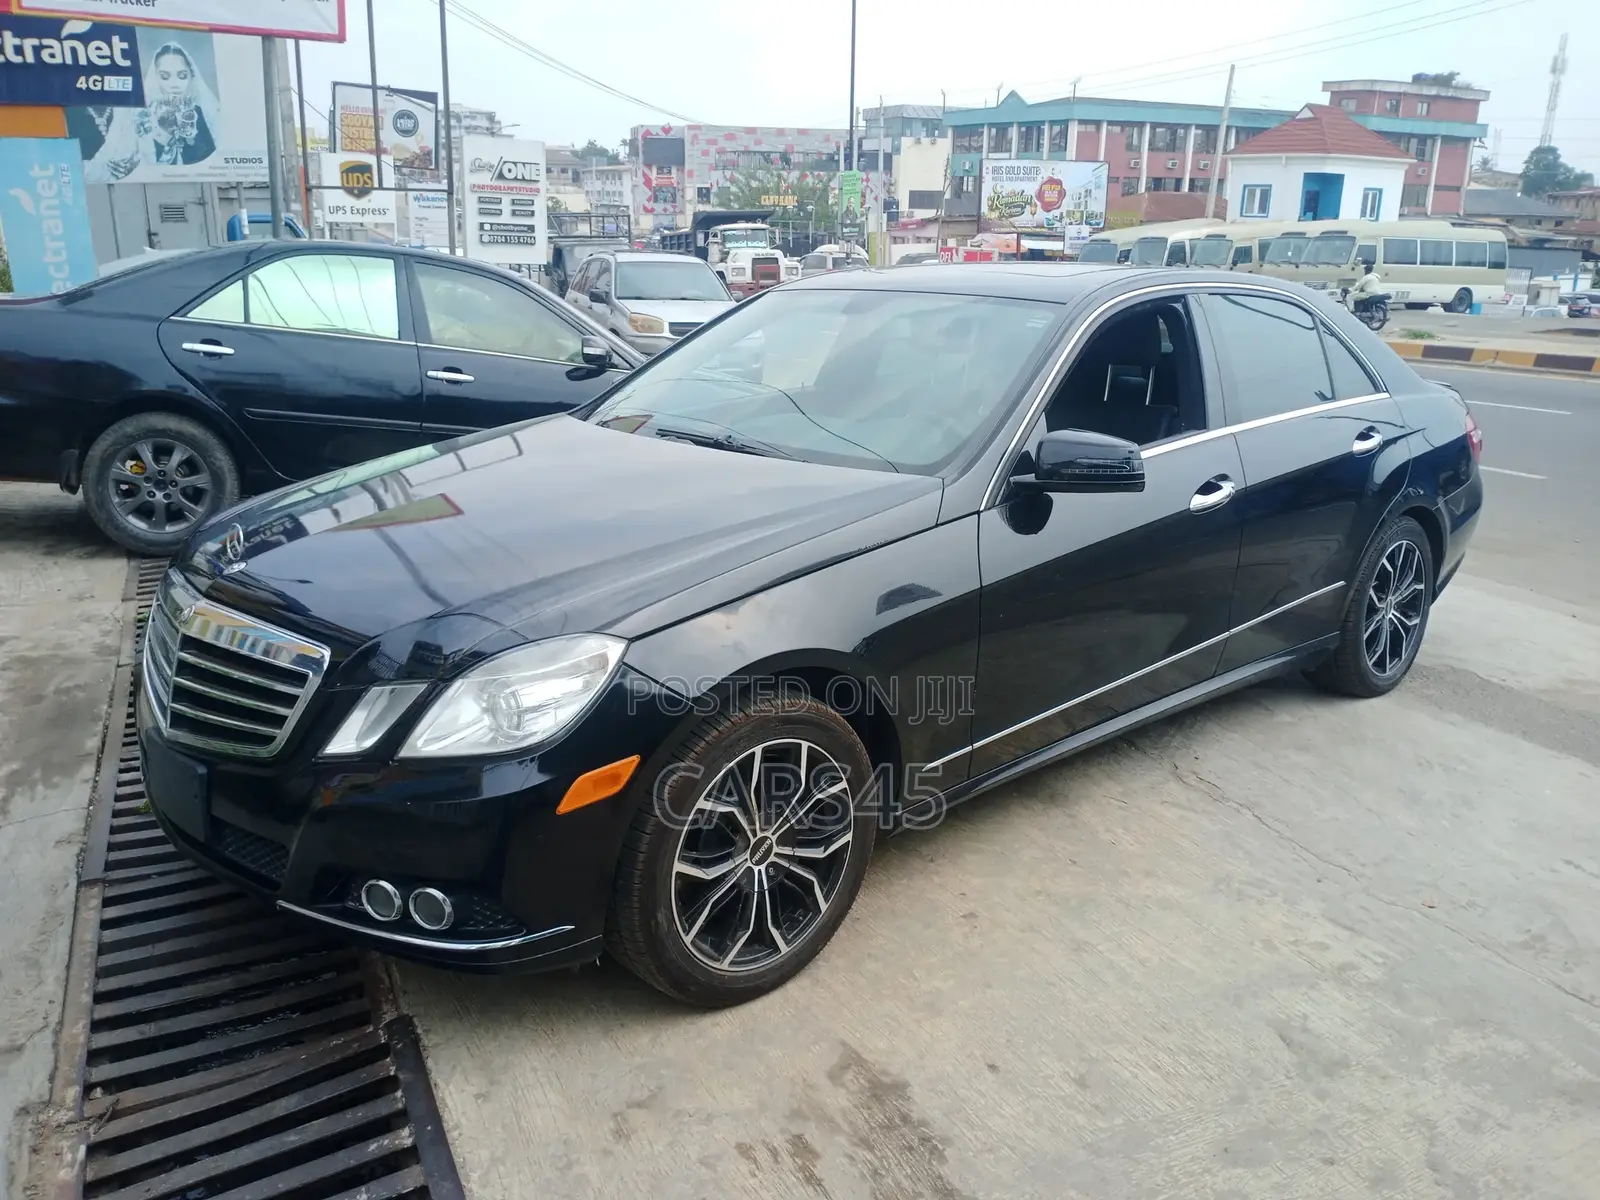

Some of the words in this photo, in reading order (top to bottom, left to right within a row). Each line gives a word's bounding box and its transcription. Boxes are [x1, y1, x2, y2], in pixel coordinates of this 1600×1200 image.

[991, 165, 1004, 175] IRIS
[1005, 165, 1022, 175] GOLD
[991, 189, 1033, 208] Ramadan
[328, 206, 347, 215] UPS
